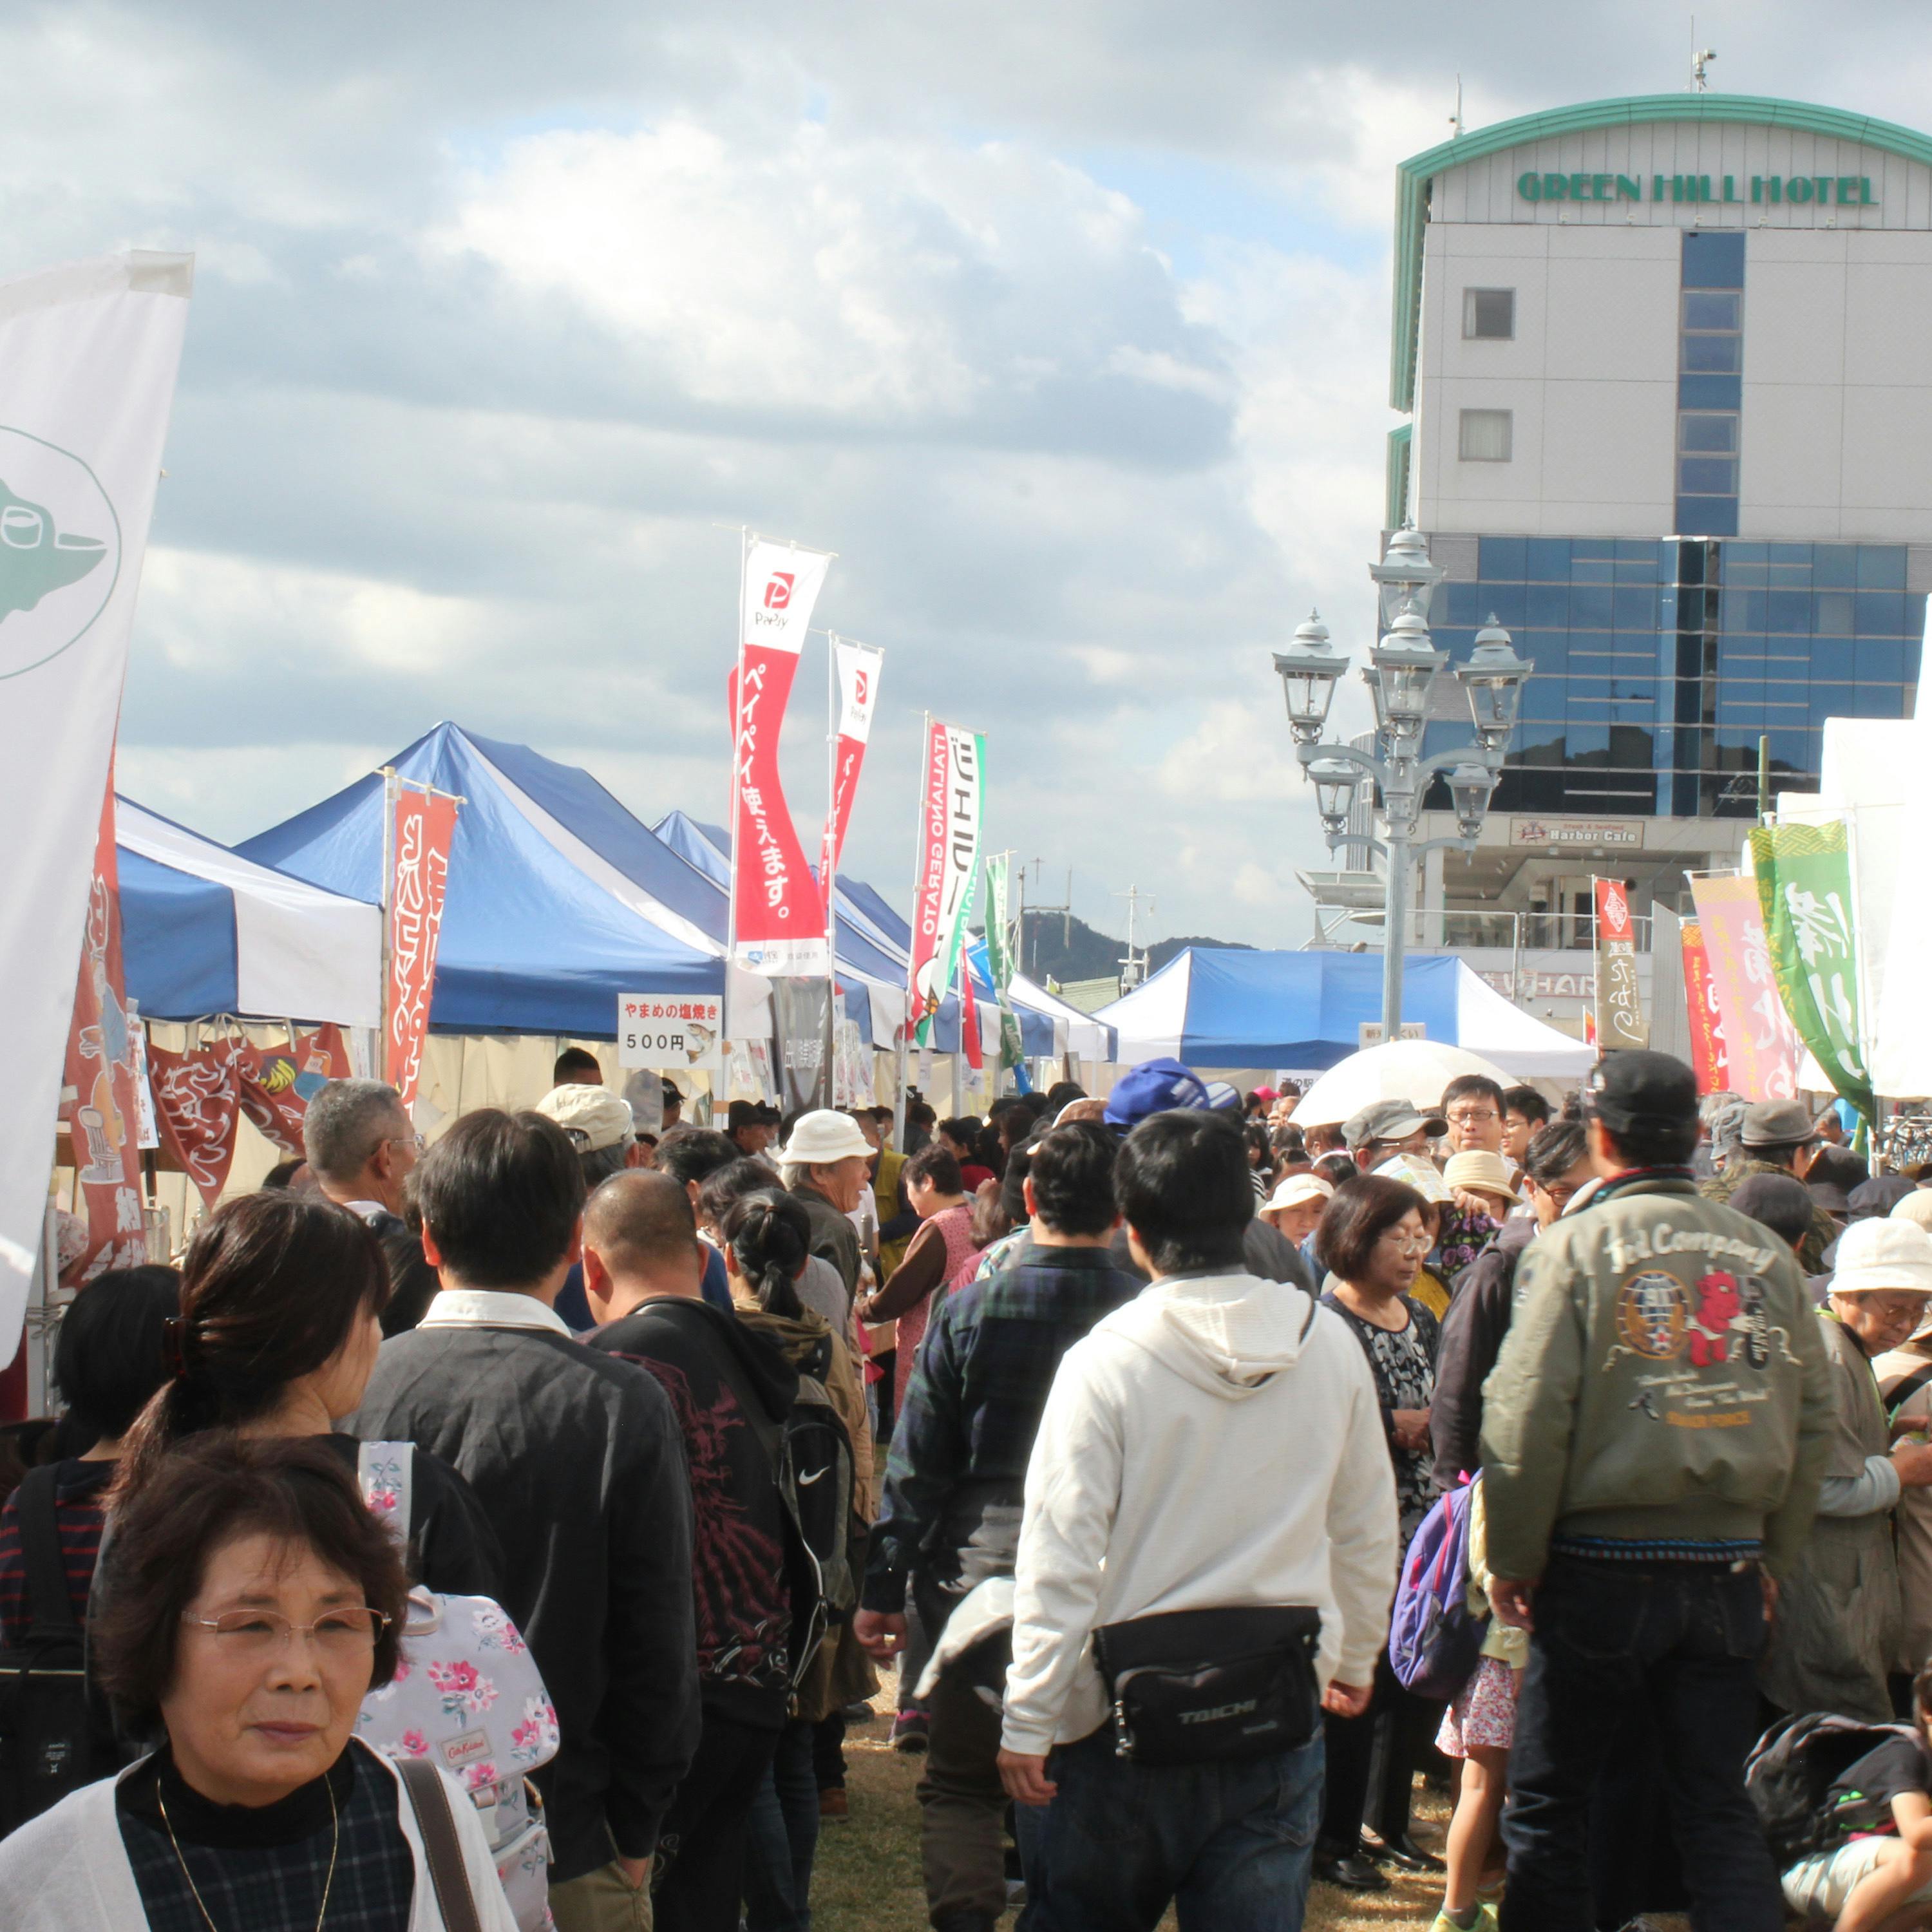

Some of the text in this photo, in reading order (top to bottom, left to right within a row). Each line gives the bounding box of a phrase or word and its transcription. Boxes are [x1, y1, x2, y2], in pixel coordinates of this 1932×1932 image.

[1517, 171, 1880, 205] GREEN HILL HOTEL
[739, 662, 790, 920] ペイペイ使えます。
[1549, 829, 1636, 842] Harbor Cafe
[625, 1003, 717, 1020] やまめの塩焼き
[1652, 1223, 1779, 1274] Company
